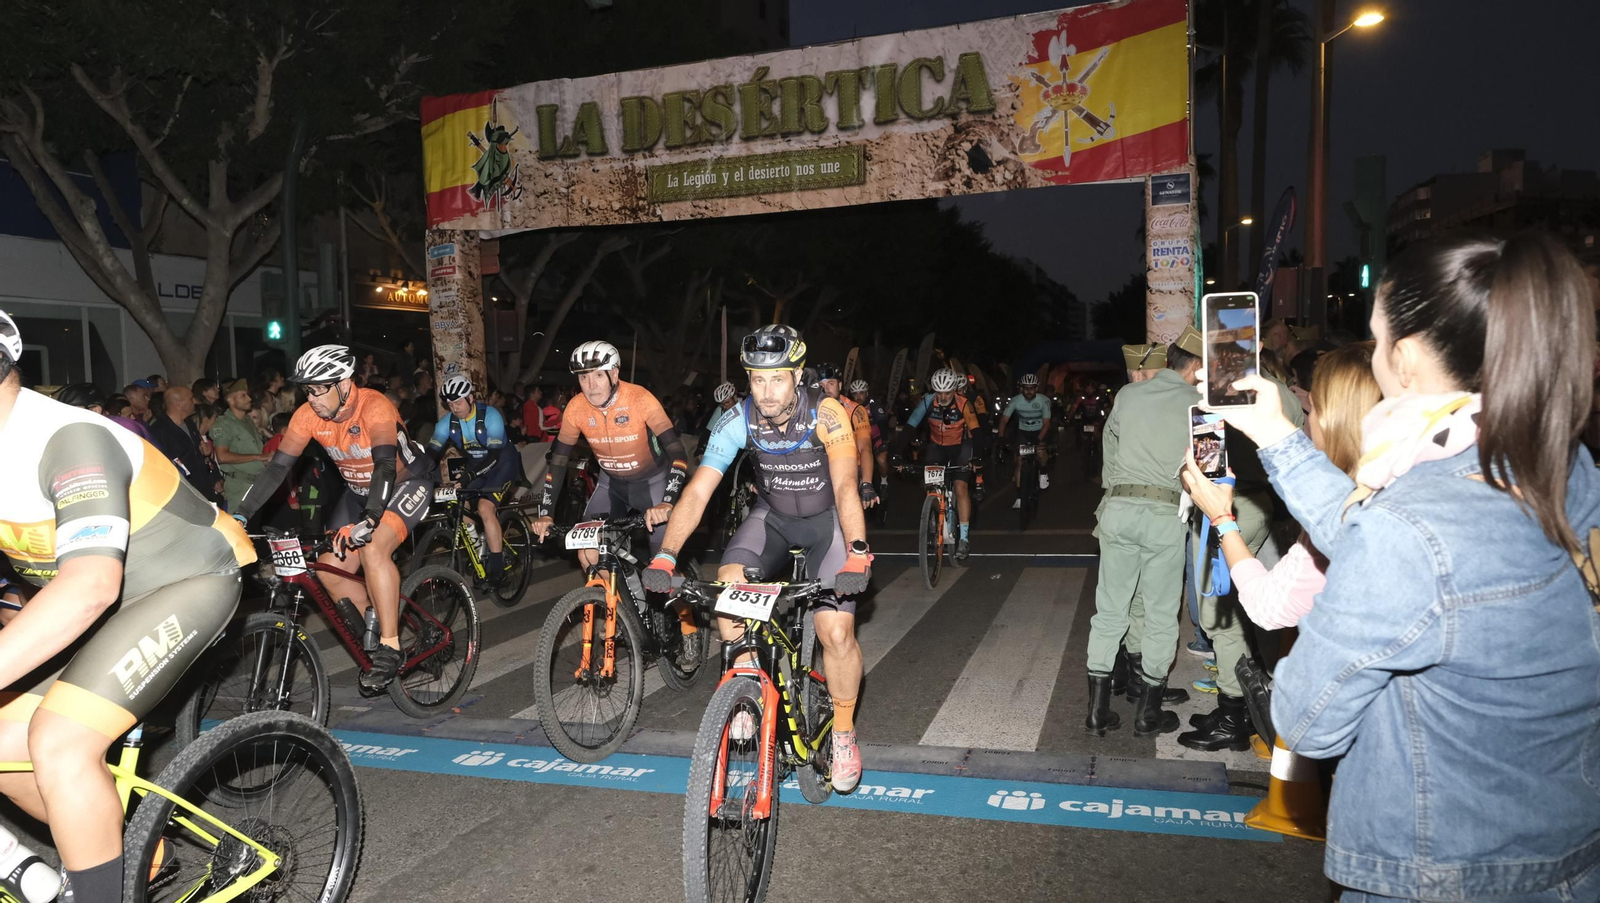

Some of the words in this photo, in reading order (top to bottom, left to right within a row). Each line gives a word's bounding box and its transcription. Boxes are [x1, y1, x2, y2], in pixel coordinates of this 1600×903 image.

[536, 101, 610, 160] LA
[619, 51, 997, 153] DESÉRTICA
[667, 174, 679, 188] La
[683, 170, 717, 188] Legión
[722, 171, 730, 186] y
[734, 167, 744, 182] el
[748, 164, 790, 181] desierto
[796, 163, 815, 176] nos
[820, 161, 840, 174] une
[1153, 239, 1189, 247] GRUPO
[1152, 246, 1190, 257] RENTA
[614, 433, 639, 443] SPORT
[771, 476, 819, 486] Mármoles
[927, 470, 943, 479] 7672
[59, 490, 106, 508] PALFINGER
[571, 527, 597, 540] 6789
[729, 590, 772, 606] 8531
[129, 657, 170, 700] SUSPENSION
[168, 629, 198, 660] SYSTEMS
[507, 756, 655, 779] cajamar
[601, 773, 638, 783] RURAL
[879, 797, 924, 805] RURAL
[1153, 817, 1195, 826] CAJA
[1200, 820, 1254, 830] RURAL
